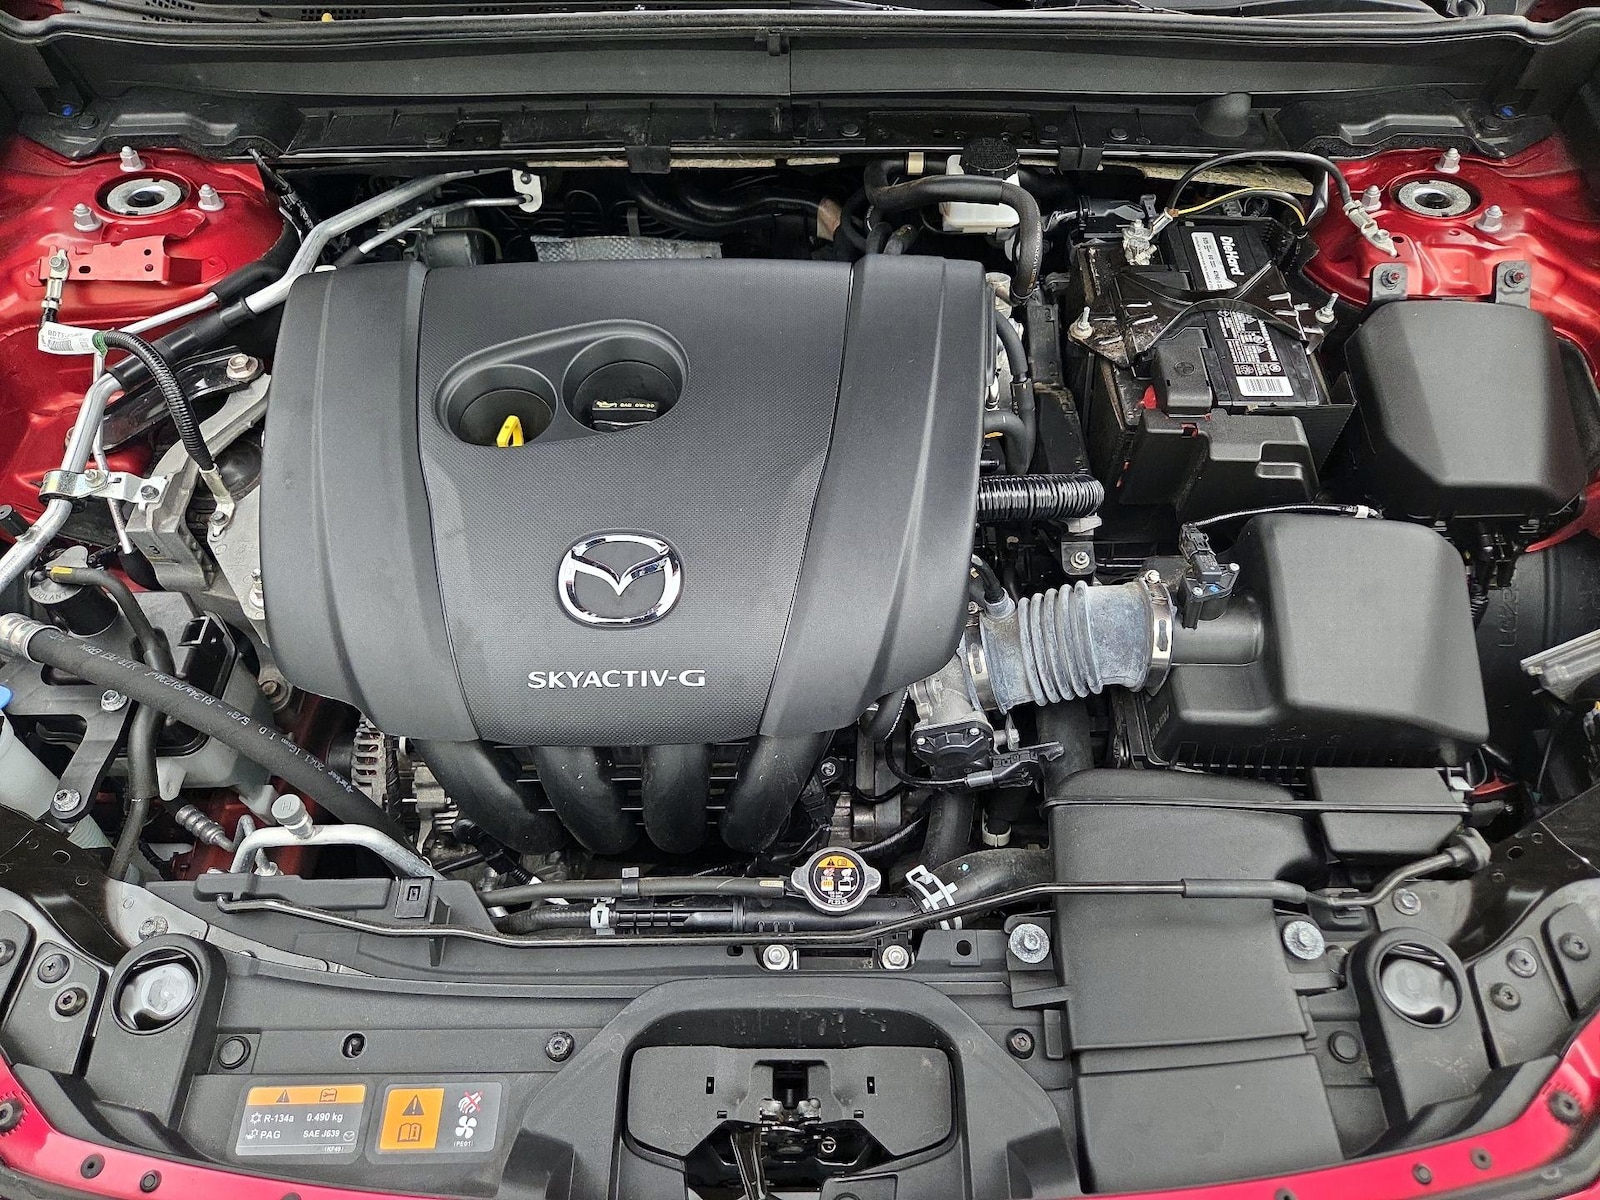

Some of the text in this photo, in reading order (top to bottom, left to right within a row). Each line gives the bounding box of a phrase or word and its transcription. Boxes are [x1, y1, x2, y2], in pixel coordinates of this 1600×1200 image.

[1220, 235, 1245, 276] DieHard
[527, 669, 706, 689] SKYACTIV-G
[263, 1112, 344, 1123] R-134a 0.490 kg
[260, 1129, 340, 1139] PAG SAE J639
